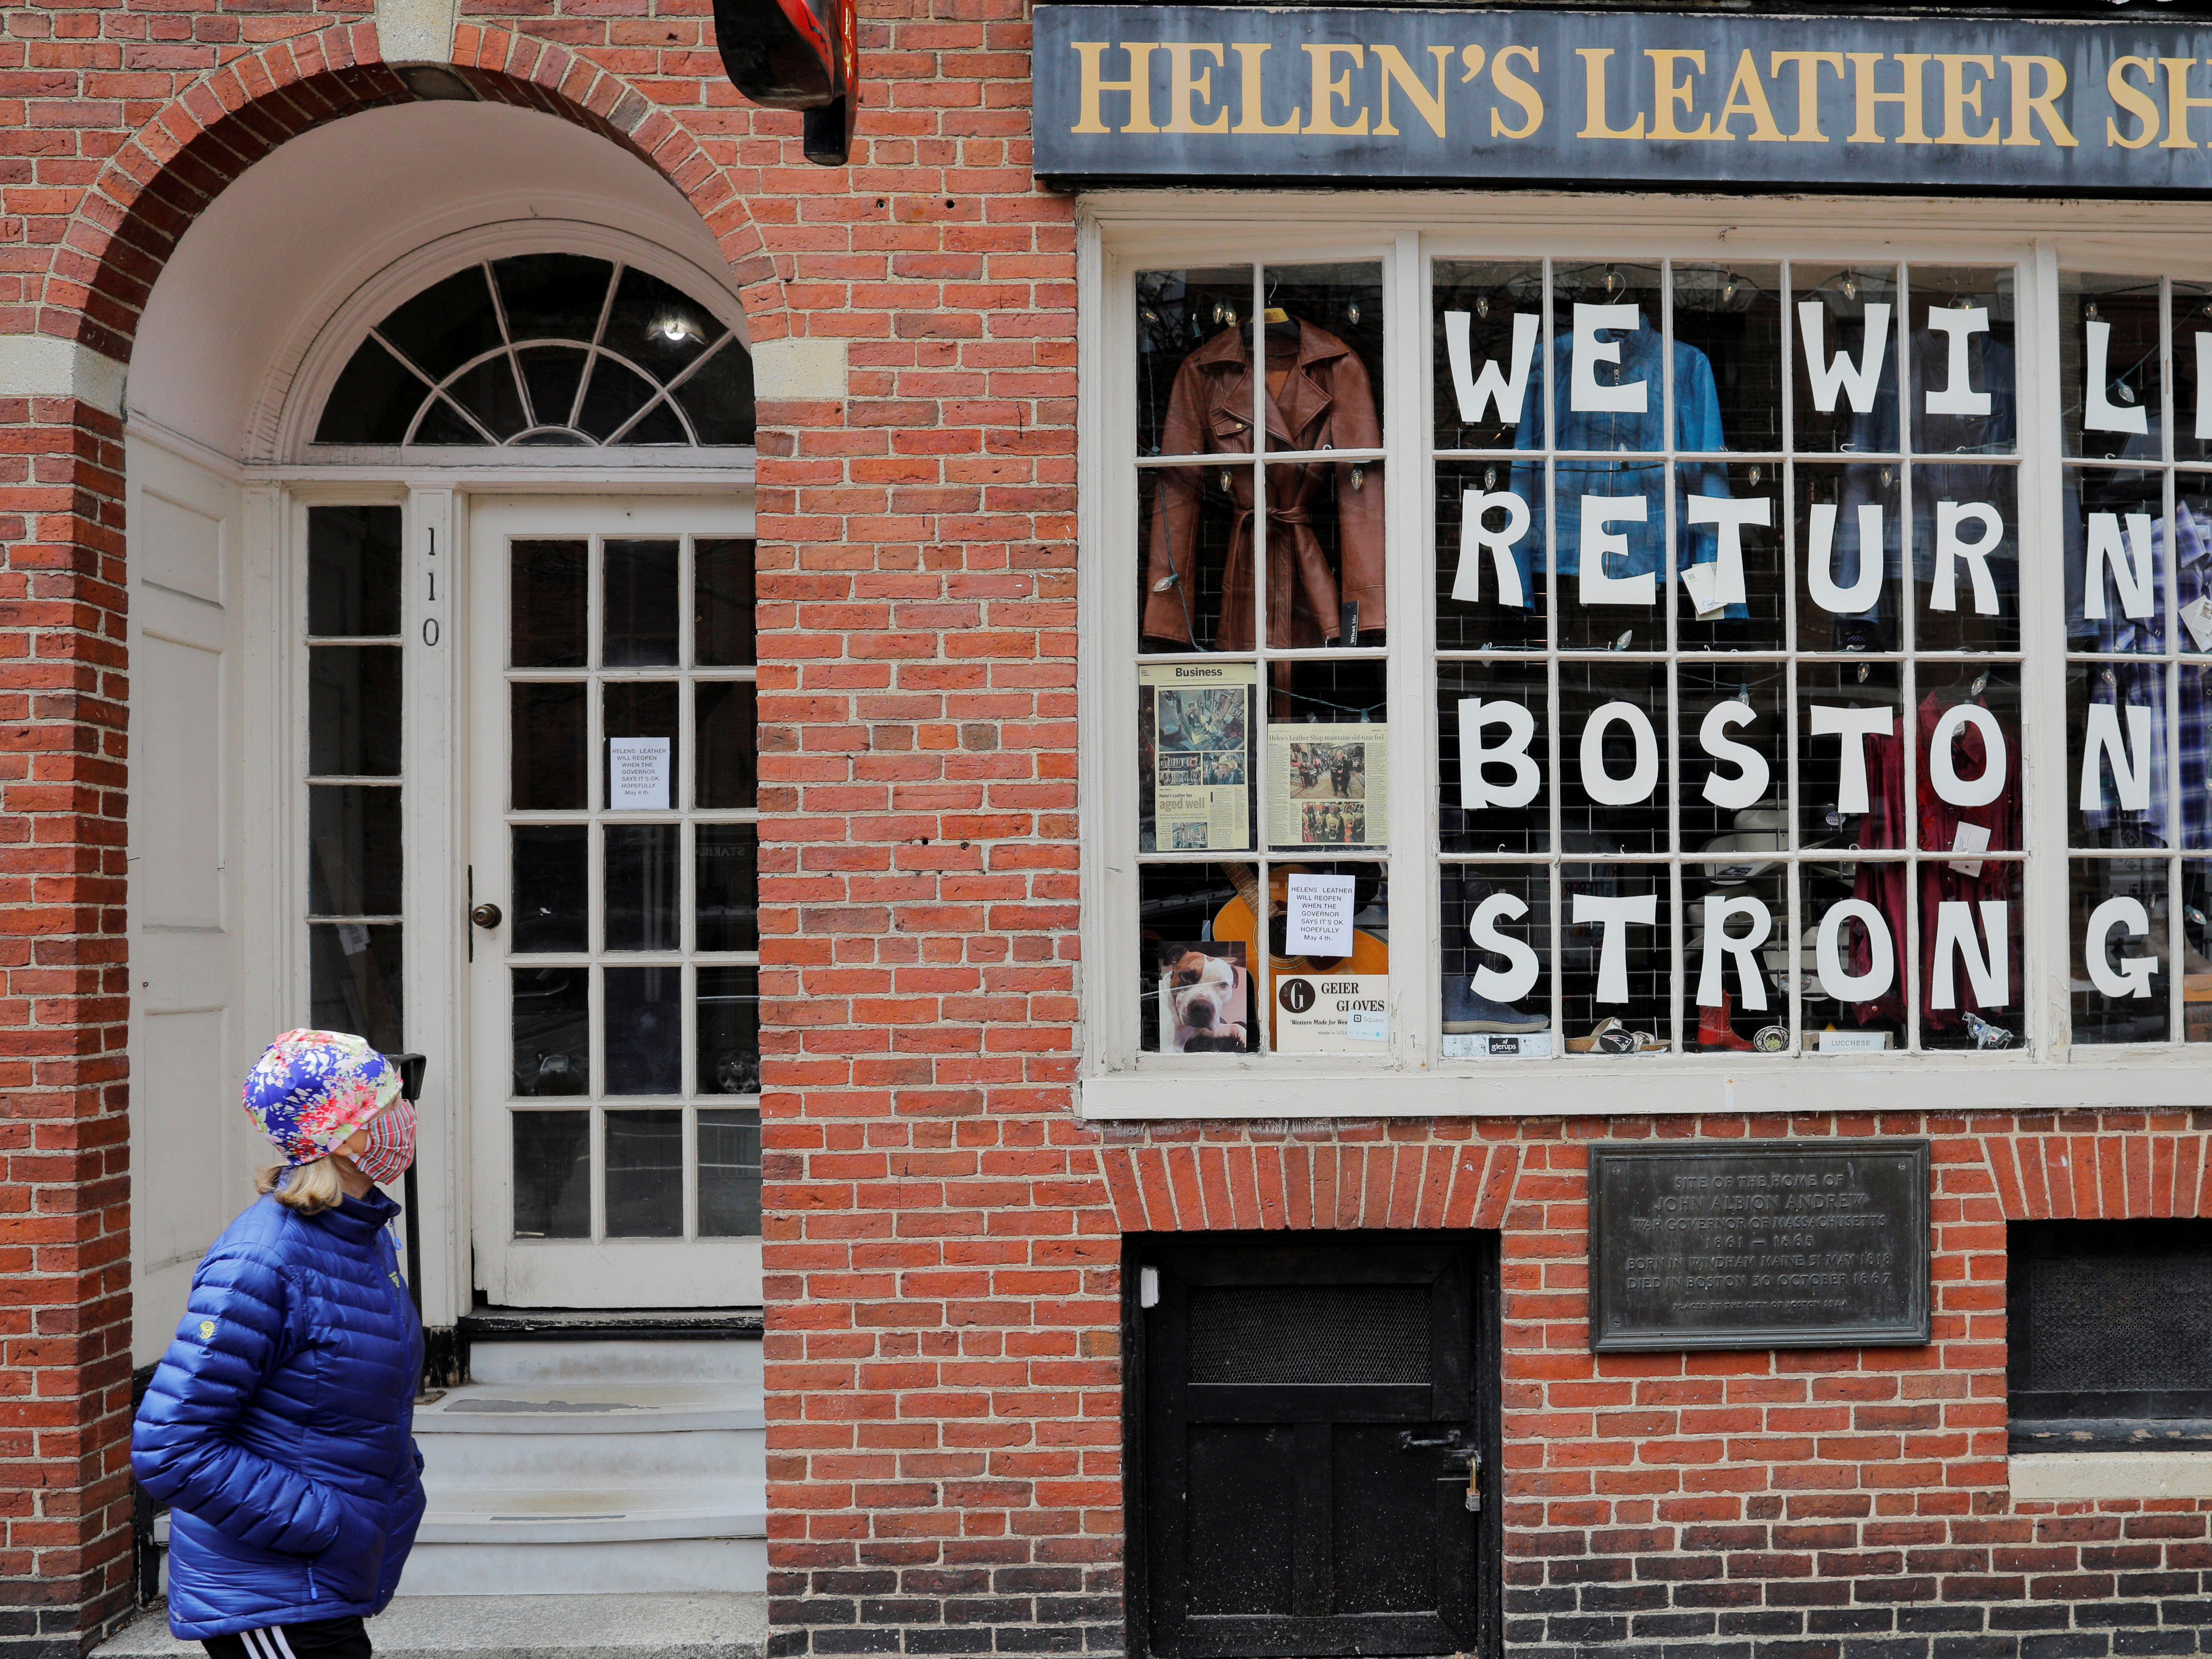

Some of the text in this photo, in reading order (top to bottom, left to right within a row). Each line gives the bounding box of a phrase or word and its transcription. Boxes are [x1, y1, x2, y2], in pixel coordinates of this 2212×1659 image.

[1071, 42, 1544, 139] HELEN'S
[1575, 48, 2079, 147] LEATHER
[1444, 301, 2212, 440] WE WIL
[1451, 490, 2155, 619] RETURN
[422, 527, 439, 646] 110
[1175, 667, 1222, 677] Business
[1458, 697, 2152, 813] BOSTON
[1160, 797, 1205, 812] aged well
[1469, 893, 2159, 1011] STRONG
[1290, 982, 1304, 1010] G
[1321, 983, 1359, 994] GEIER
[1336, 1000, 1385, 1012] GLOVES
[1491, 1043, 1516, 1051] glerups
[1676, 1175, 1843, 1189] SITE OF THE HOME OF
[1655, 1194, 1865, 1211] JOHN ALBION ANDREW
[1633, 1216, 1886, 1230] WAR GOVERNOR OF MASSACHUSETTS
[1706, 1237, 1743, 1248] 1861
[1774, 1234, 1813, 1247] 1865
[1627, 1253, 1891, 1270] BORN IN WINDHAM MAINE 31 MAY 1818
[1628, 1273, 1891, 1289] DIED IN BOSTON 30 OCTOBER 1867
